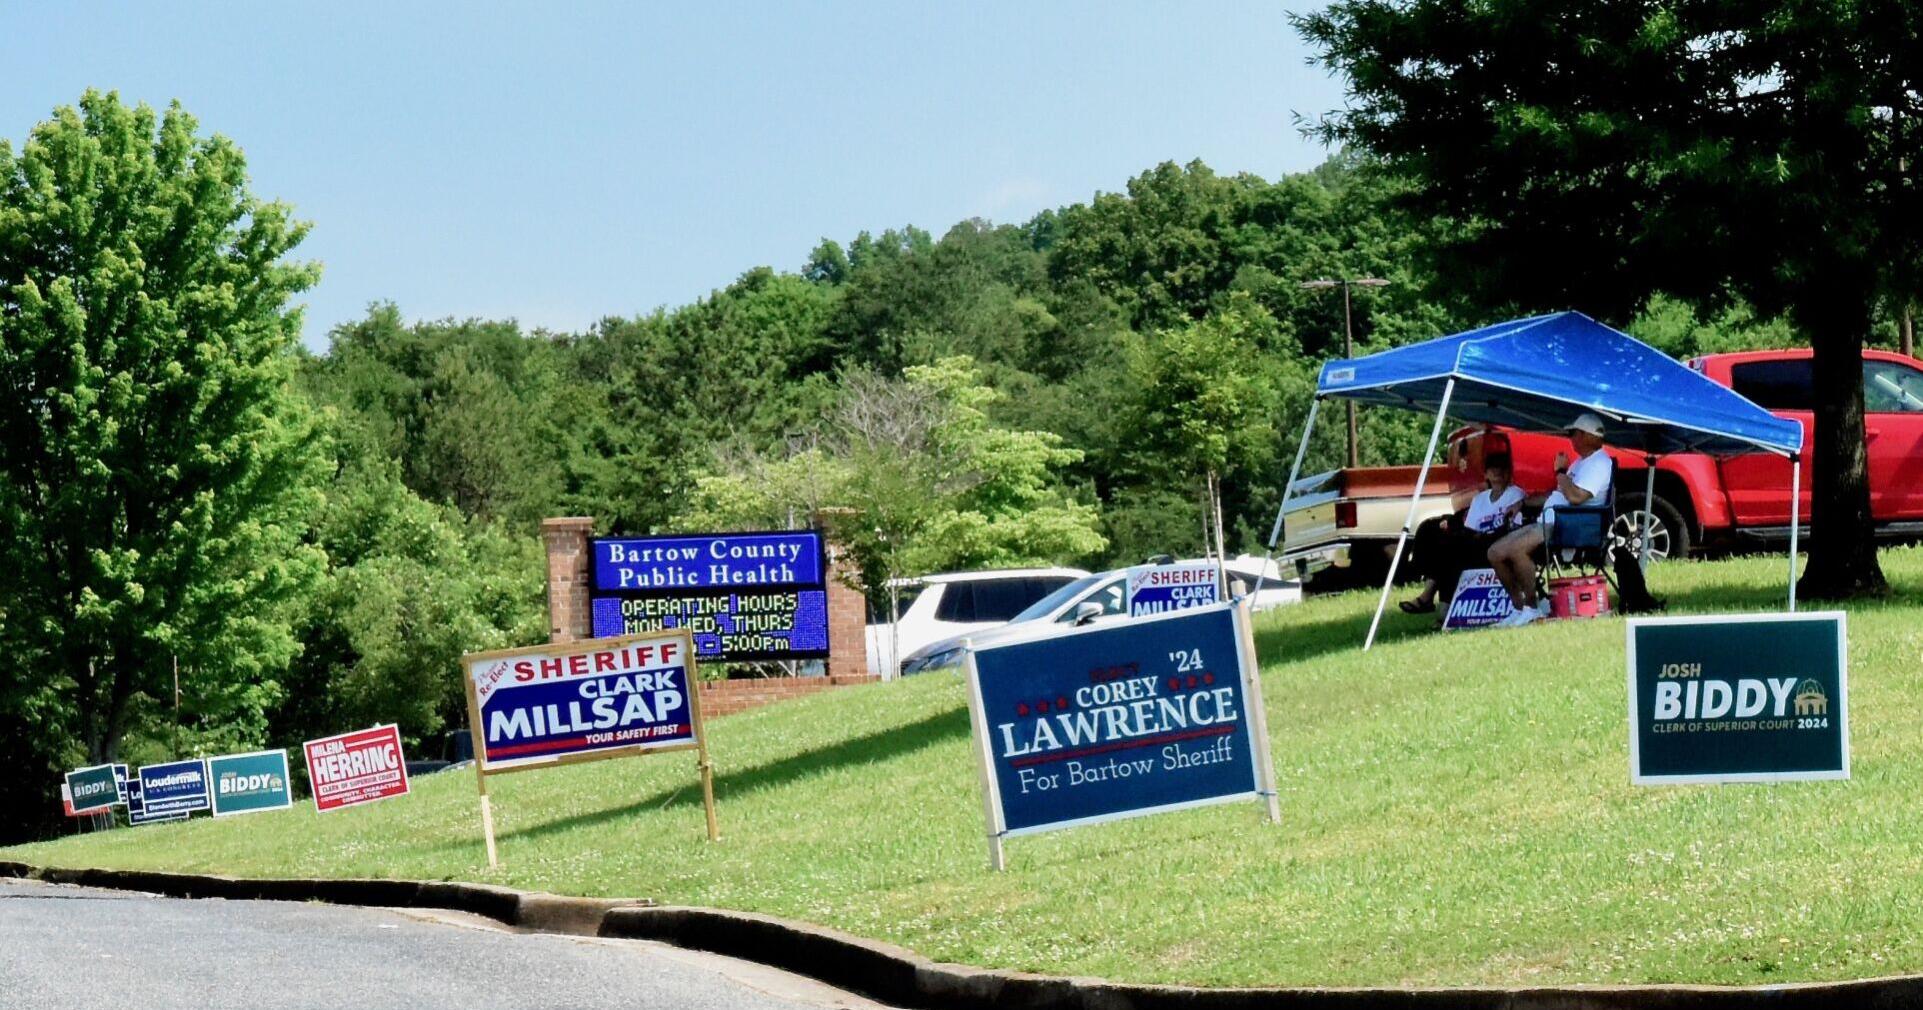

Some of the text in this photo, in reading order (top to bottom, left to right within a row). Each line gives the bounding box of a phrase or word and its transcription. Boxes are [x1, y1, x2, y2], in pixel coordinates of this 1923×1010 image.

[610, 541, 802, 564] Bartow County
[619, 563, 795, 588] Public Health
[1151, 569, 1215, 585] SHERIFF
[621, 593, 797, 616] OPERATING HOURS
[1171, 587, 1212, 600] CLARK
[732, 613, 794, 632] THURS
[513, 643, 678, 683] SHERIFF
[1169, 648, 1204, 673] '24
[1658, 663, 1701, 679] JOSH
[578, 670, 678, 699] CLARK
[1075, 675, 1159, 709] COREY
[1654, 677, 1798, 720] BIDDY
[489, 690, 683, 743] MILLSAP
[998, 687, 1238, 758] LAWRENCE
[1652, 718, 1828, 733] CLERK OF SUPERIOR COURT 2024
[586, 724, 679, 745] YOUR SAFETY FIRST
[311, 741, 346, 758] MILENA
[312, 743, 399, 784] HERRING
[1017, 735, 1233, 794] For Bartow Sheriff
[74, 781, 106, 797] BIDDY
[145, 771, 202, 789] Loudermilk
[219, 773, 271, 794] BIDDY
